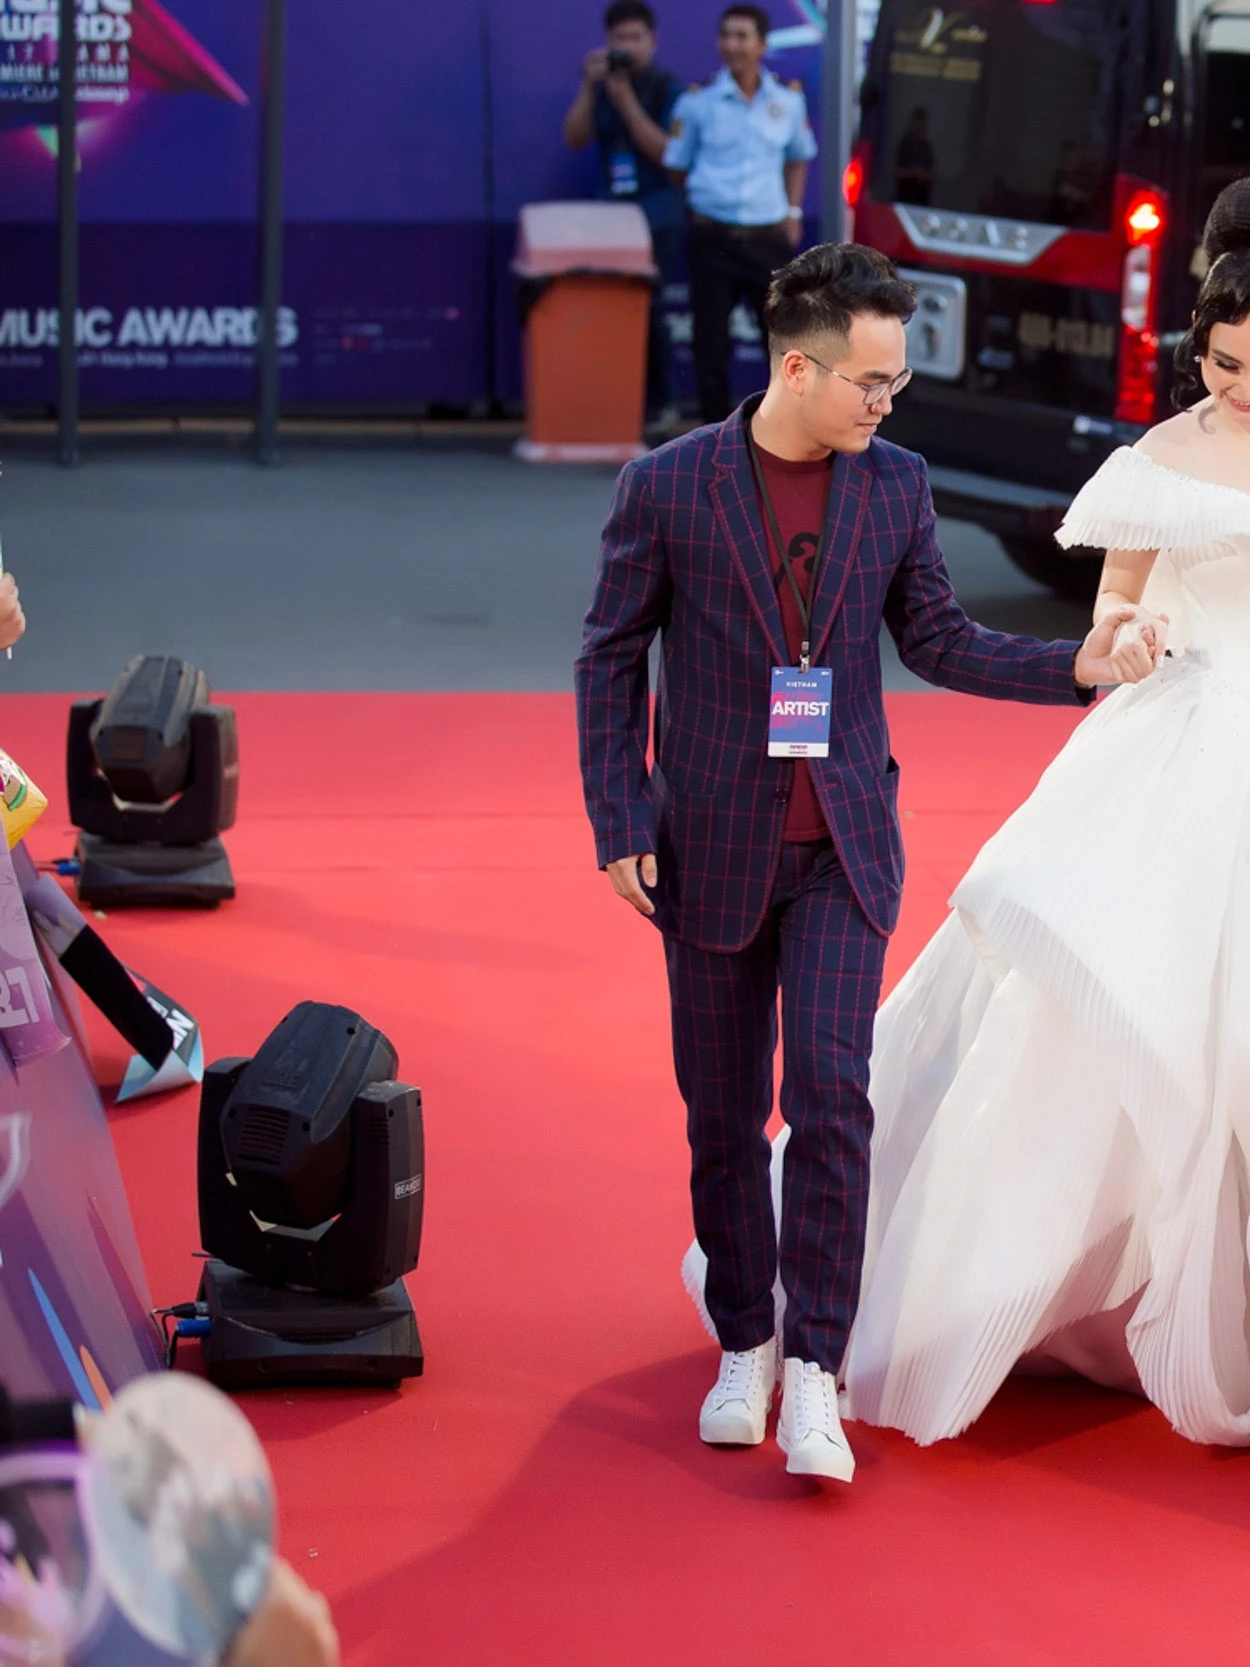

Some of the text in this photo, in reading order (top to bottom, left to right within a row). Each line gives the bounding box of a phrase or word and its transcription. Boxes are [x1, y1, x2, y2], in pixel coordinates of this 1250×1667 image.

[76, 63, 129, 82] IETNAM
[117, 307, 299, 347] AWARDS
[786, 681, 817, 689] VIETNAM
[772, 701, 829, 716] ARTIST
